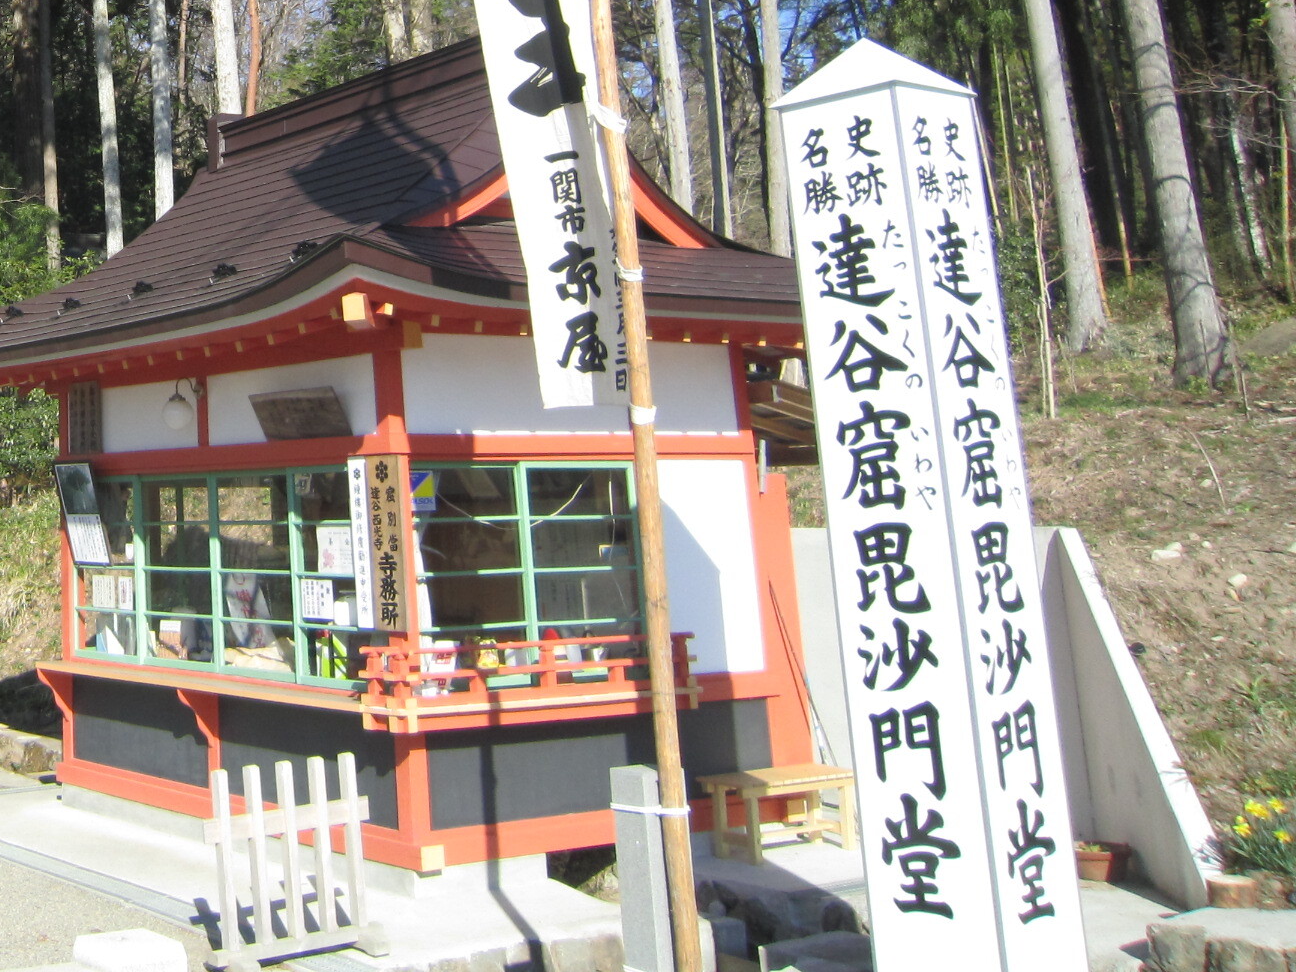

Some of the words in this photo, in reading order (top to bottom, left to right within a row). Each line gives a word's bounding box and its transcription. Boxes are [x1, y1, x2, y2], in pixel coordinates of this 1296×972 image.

[801, 128, 843, 215] 名勝
[846, 115, 888, 207] 史跡
[912, 115, 944, 203] 名勝
[944, 117, 972, 208] 史跡
[378, 551, 399, 630] 寺務所
[812, 214, 961, 920] 達谷窟毘沙門堂
[925, 208, 1055, 924] 達谷窟毘沙門堂
